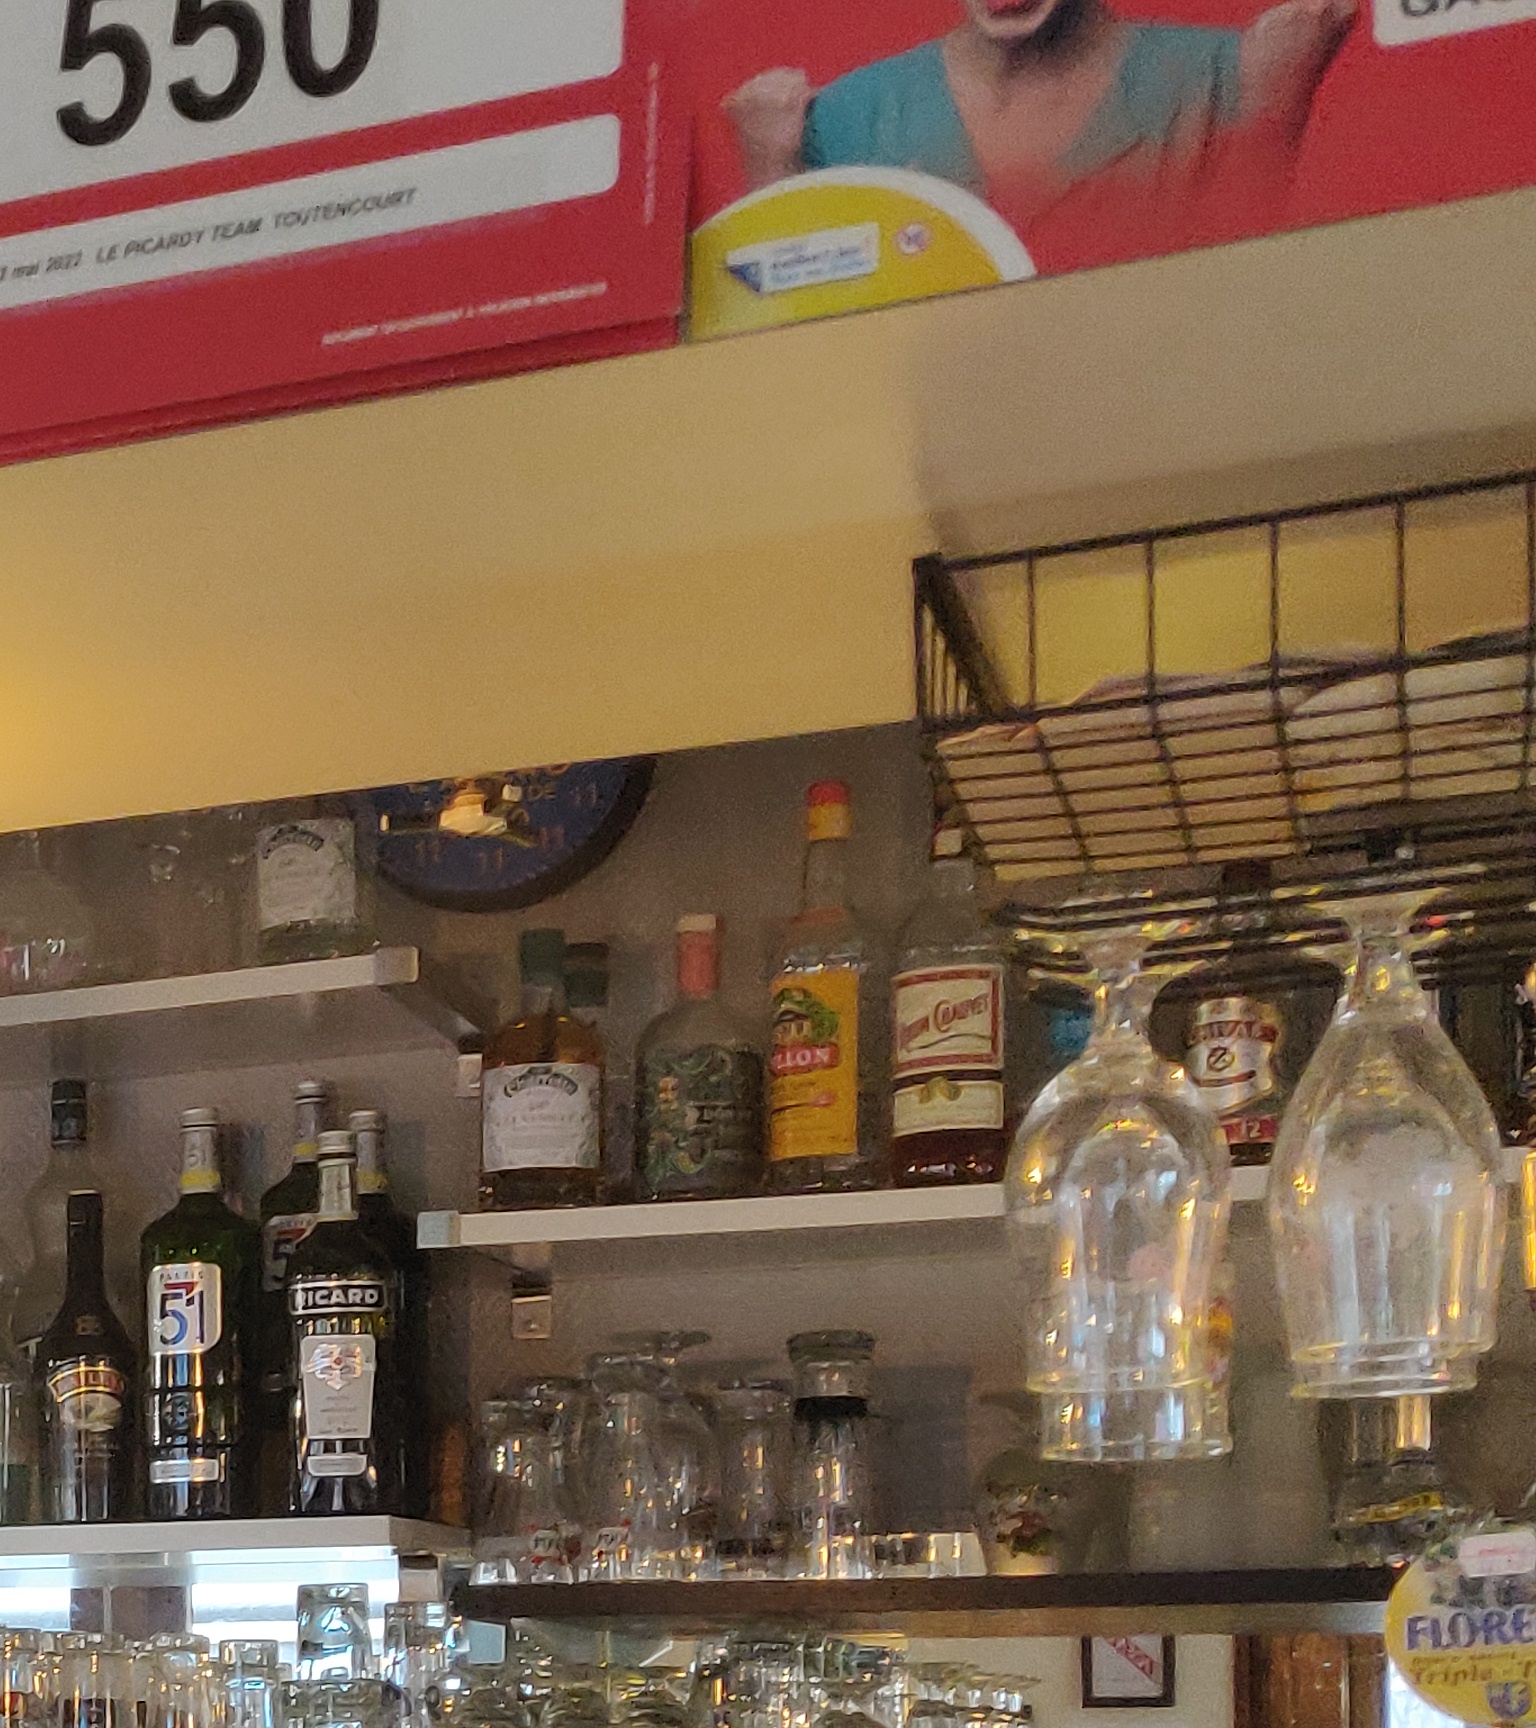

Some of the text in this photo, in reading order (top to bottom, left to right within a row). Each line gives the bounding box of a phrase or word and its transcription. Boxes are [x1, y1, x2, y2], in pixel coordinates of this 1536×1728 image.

[55, 0, 379, 147] 550
[160, 1290, 204, 1345] 51
[295, 1286, 381, 1308] RICARD
